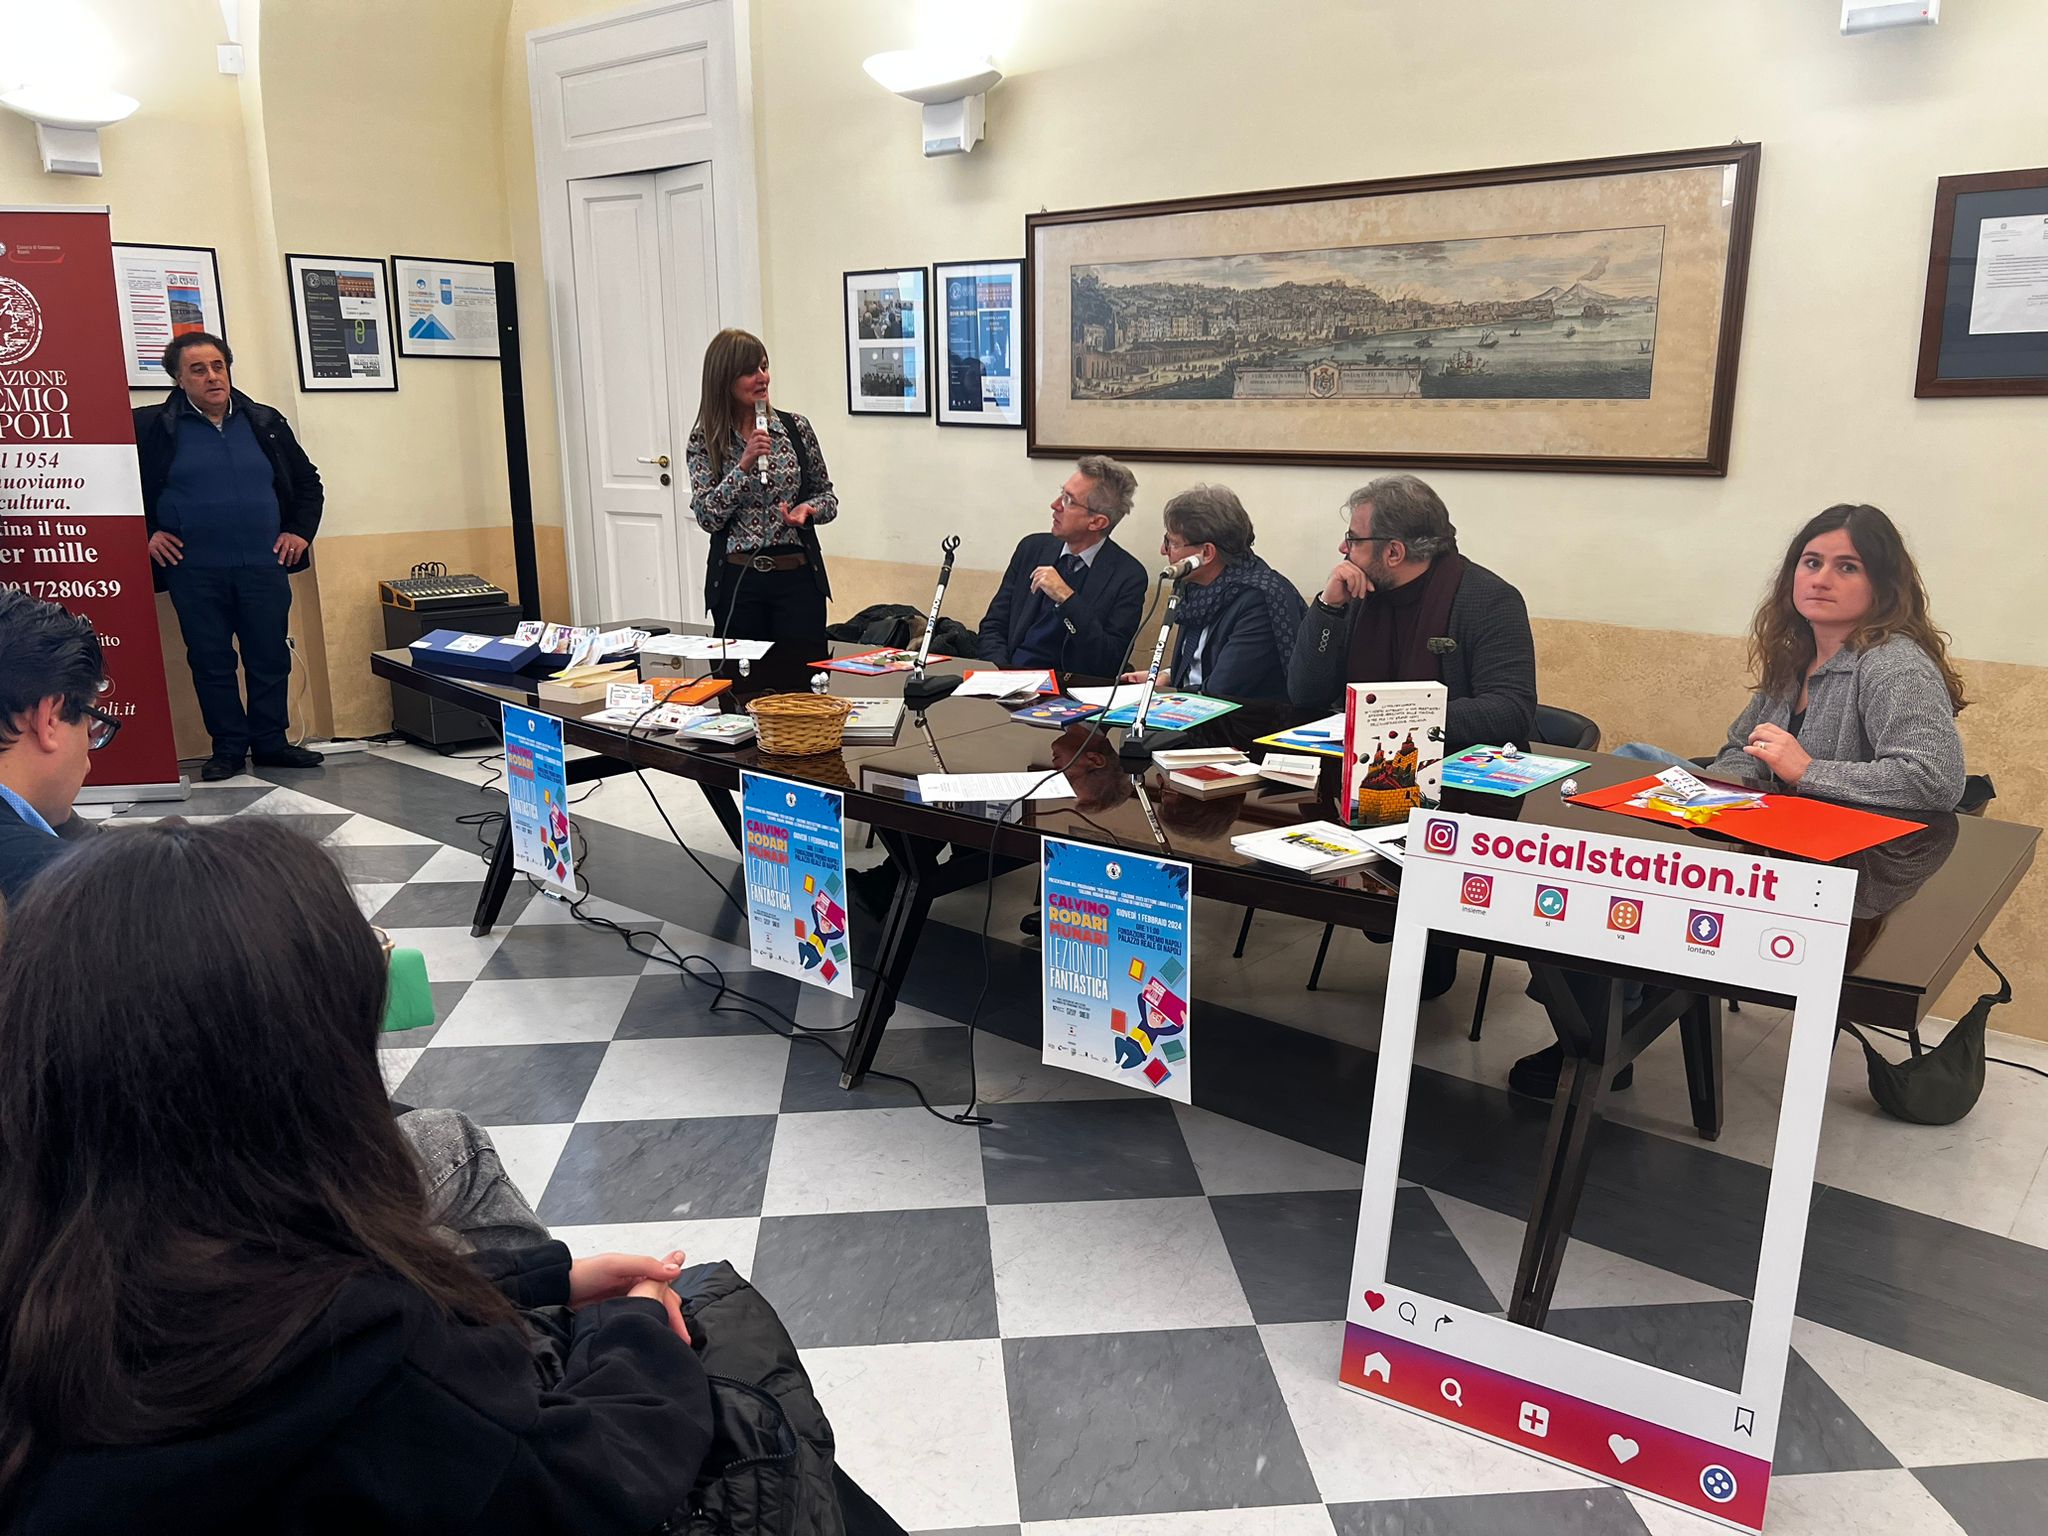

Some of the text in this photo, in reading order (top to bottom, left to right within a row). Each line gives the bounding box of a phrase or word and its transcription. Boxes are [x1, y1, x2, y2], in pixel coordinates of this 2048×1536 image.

[15, 451, 60, 469] 1954
[38, 520, 51, 536] il
[56, 521, 87, 537] tuo
[33, 541, 99, 563] mille
[96, 632, 120, 647] ito
[746, 819, 790, 841] CALVINO
[747, 830, 788, 852] RODARI
[748, 857, 790, 894] LEZIONI DI
[1471, 831, 1778, 902] socialstation.it
[750, 884, 791, 912] FANTASTICA
[1048, 894, 1110, 917] CALVINO
[1049, 907, 1108, 932] RODARI
[1141, 914, 1167, 927] FEBBRAIO
[1167, 920, 1182, 930] 2024
[1462, 906, 1486, 916] insieme
[1049, 921, 1109, 946] MUNARI
[1118, 933, 1140, 946] PALAZZO
[1140, 939, 1157, 950] REALE
[1163, 944, 1182, 956] NAPOLI
[1164, 937, 1182, 949] NAPOLI
[1049, 936, 1108, 980] LEZIONI DI
[1687, 945, 1715, 956] lontano
[1050, 968, 1108, 1001] FANTASTICA
